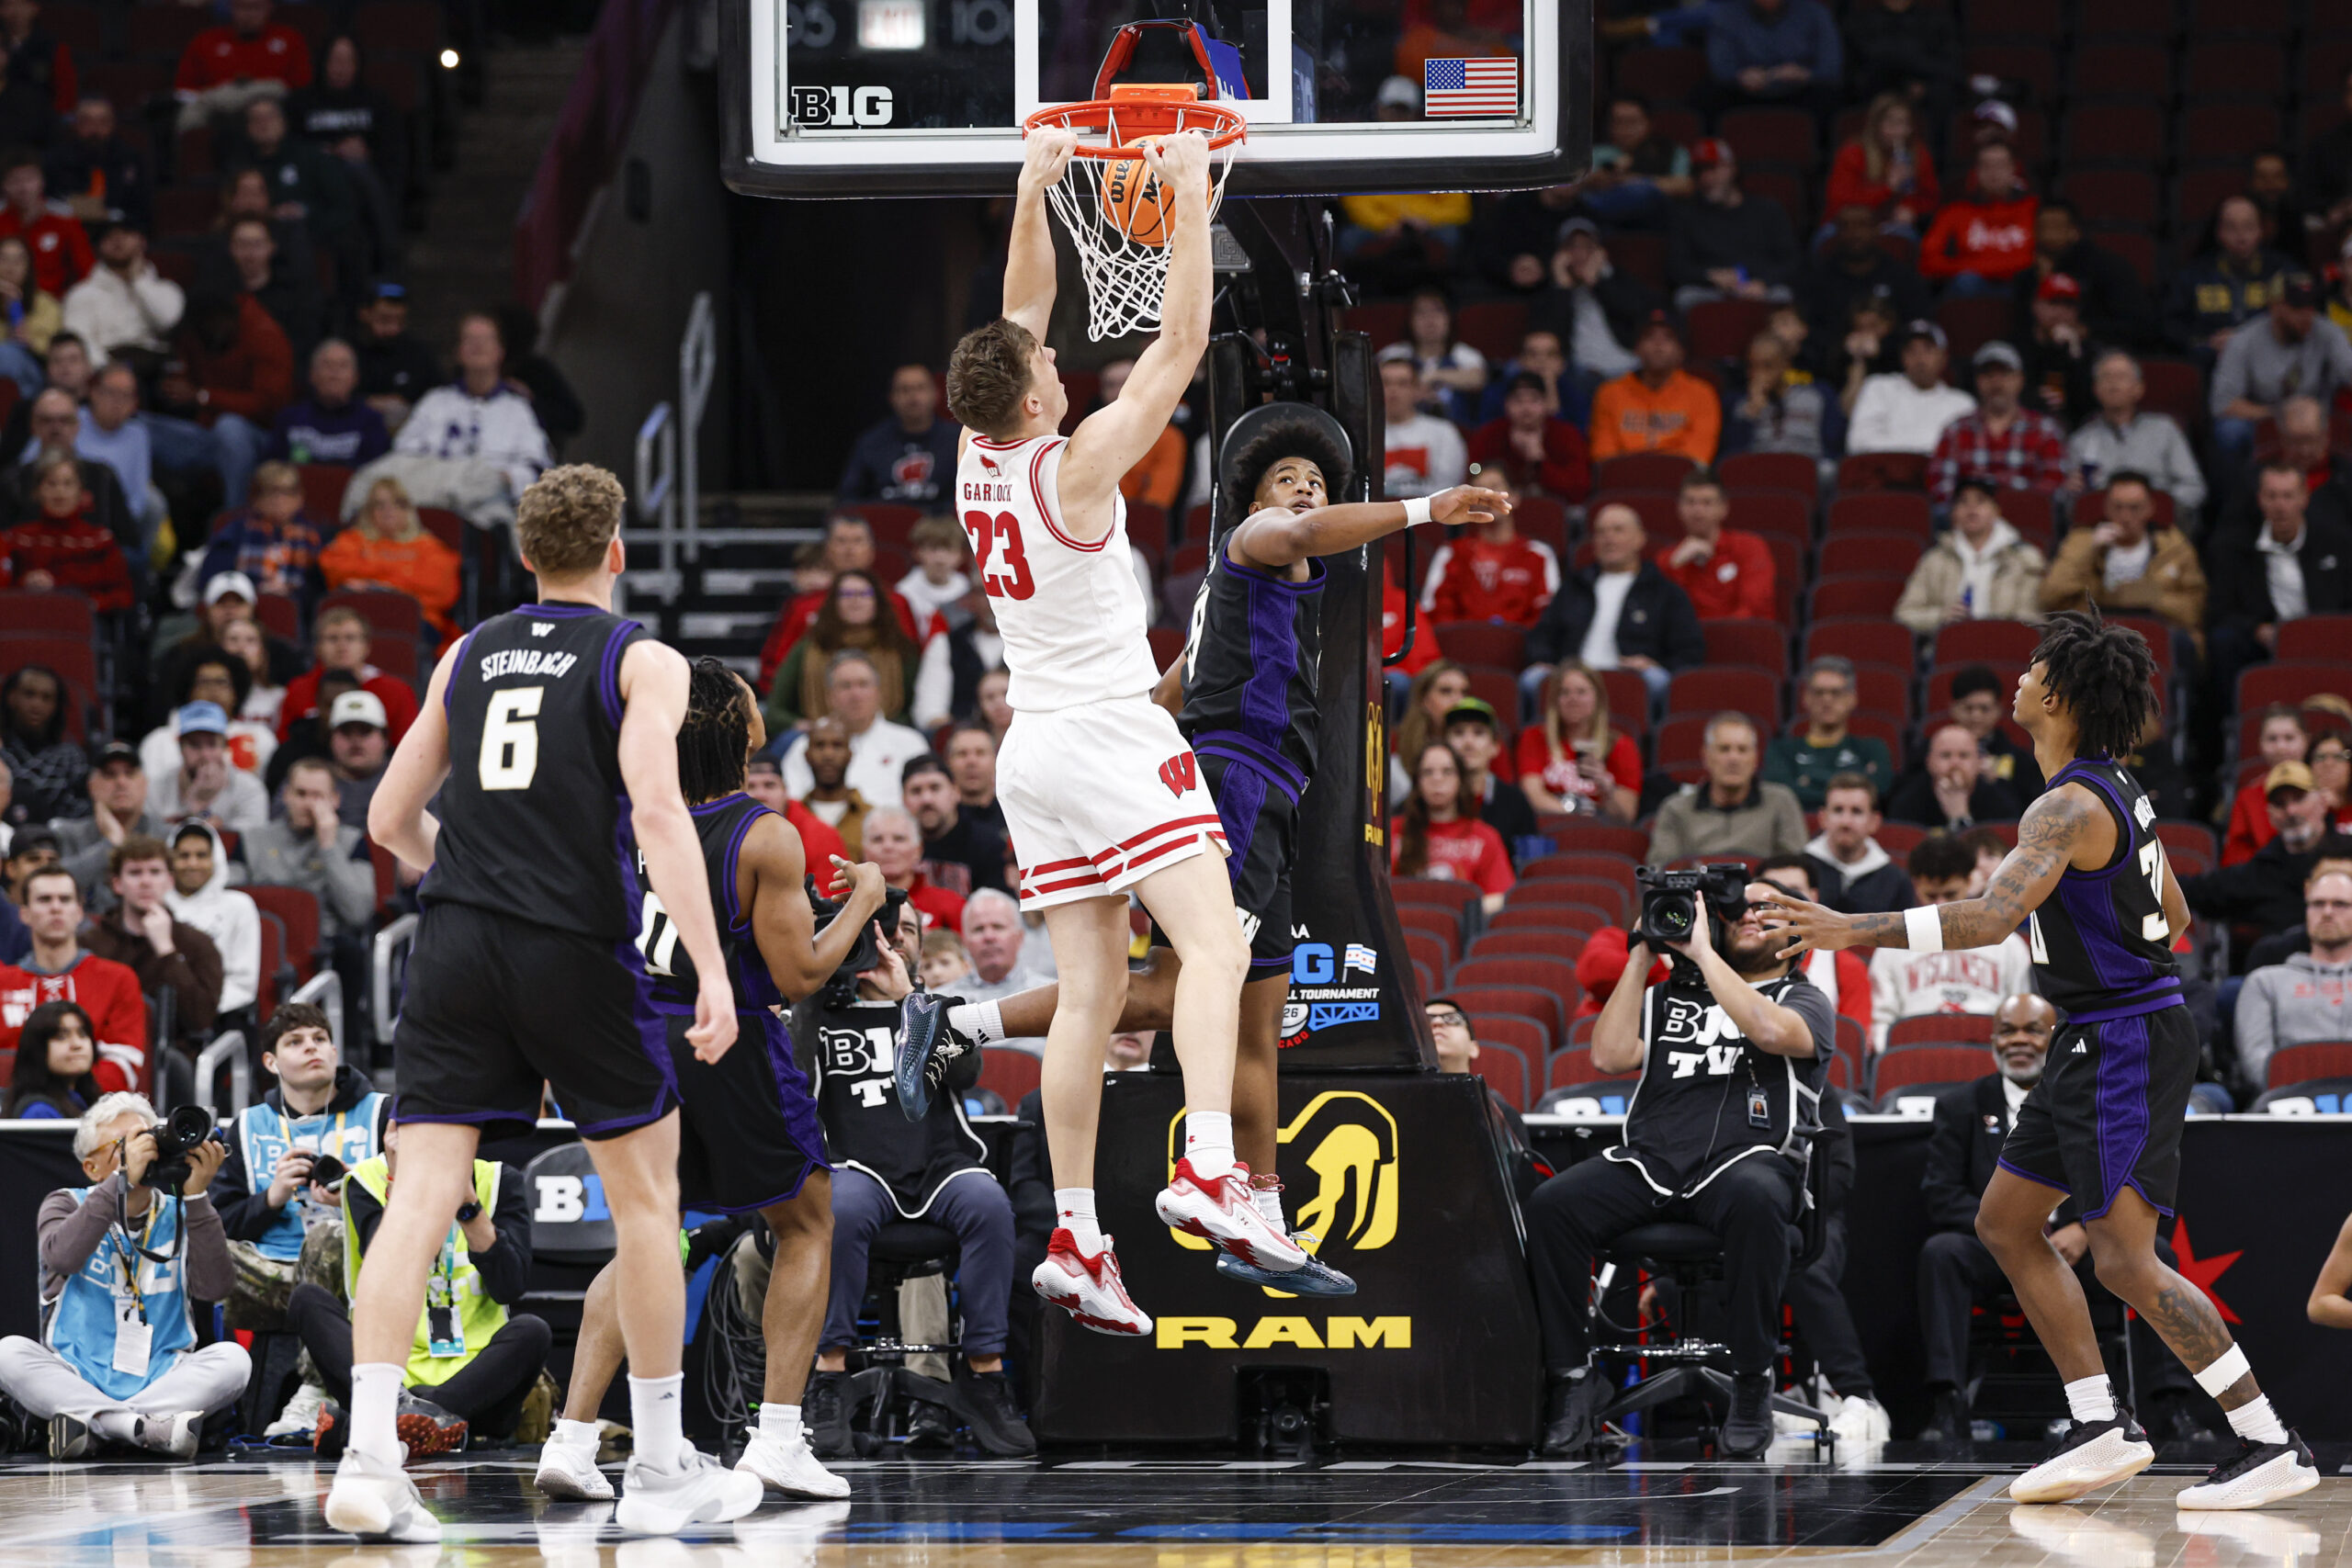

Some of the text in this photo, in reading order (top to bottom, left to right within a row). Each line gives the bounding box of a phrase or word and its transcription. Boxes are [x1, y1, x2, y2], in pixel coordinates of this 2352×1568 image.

[964, 510, 1035, 601] 23
[481, 649, 578, 682] STEINBACH
[479, 686, 544, 791] 6
[1159, 750, 1196, 799] W
[1300, 988, 1380, 999] TOURNAMENT
[1668, 1045, 1744, 1078] TV
[851, 1075, 897, 1108] T
[1156, 1316, 1411, 1348] RAM
